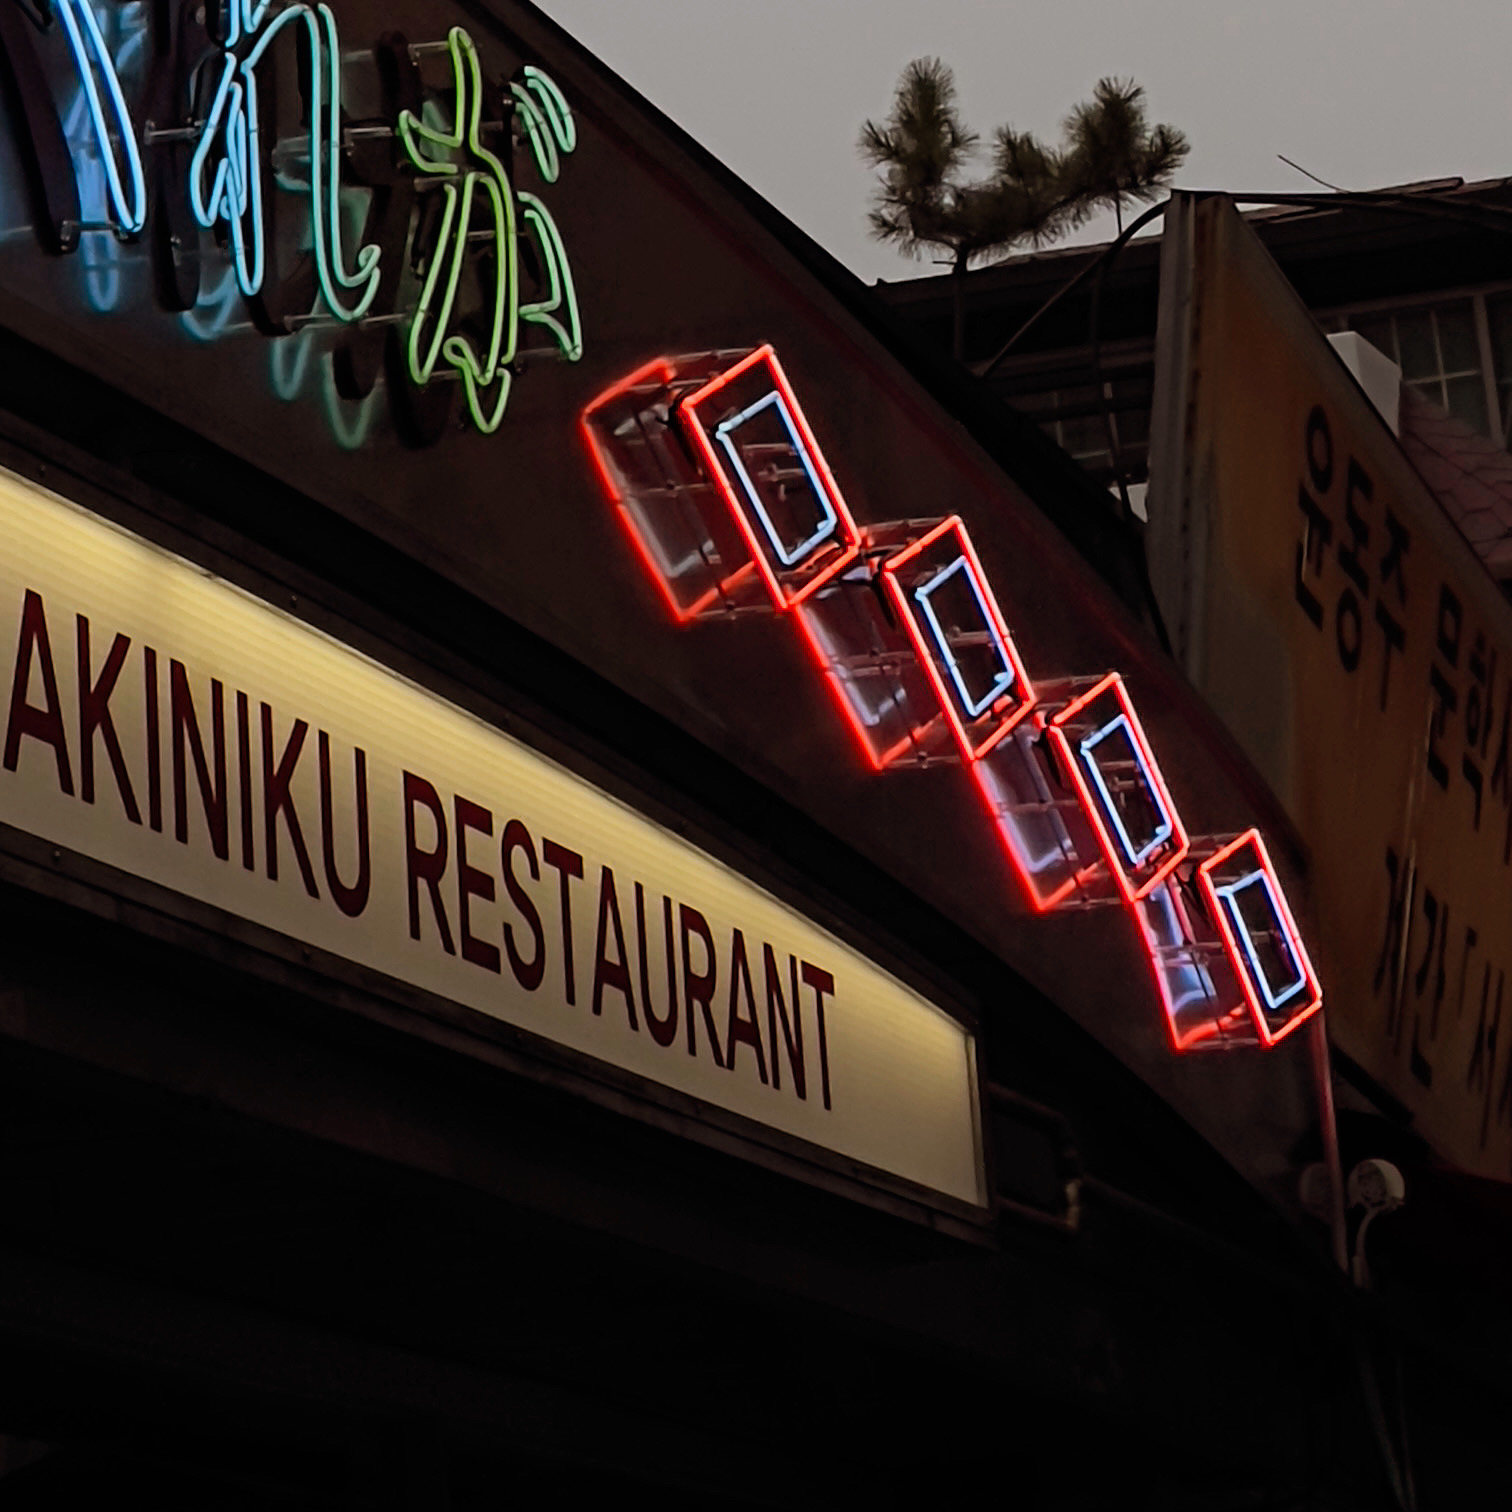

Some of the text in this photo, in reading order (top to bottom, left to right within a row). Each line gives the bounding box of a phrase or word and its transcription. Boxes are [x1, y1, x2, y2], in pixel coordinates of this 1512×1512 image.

[1296, 404, 1410, 712] 윤동주
[402, 769, 835, 1111] RESTAURANT
[1374, 845, 1449, 1090] 계간
